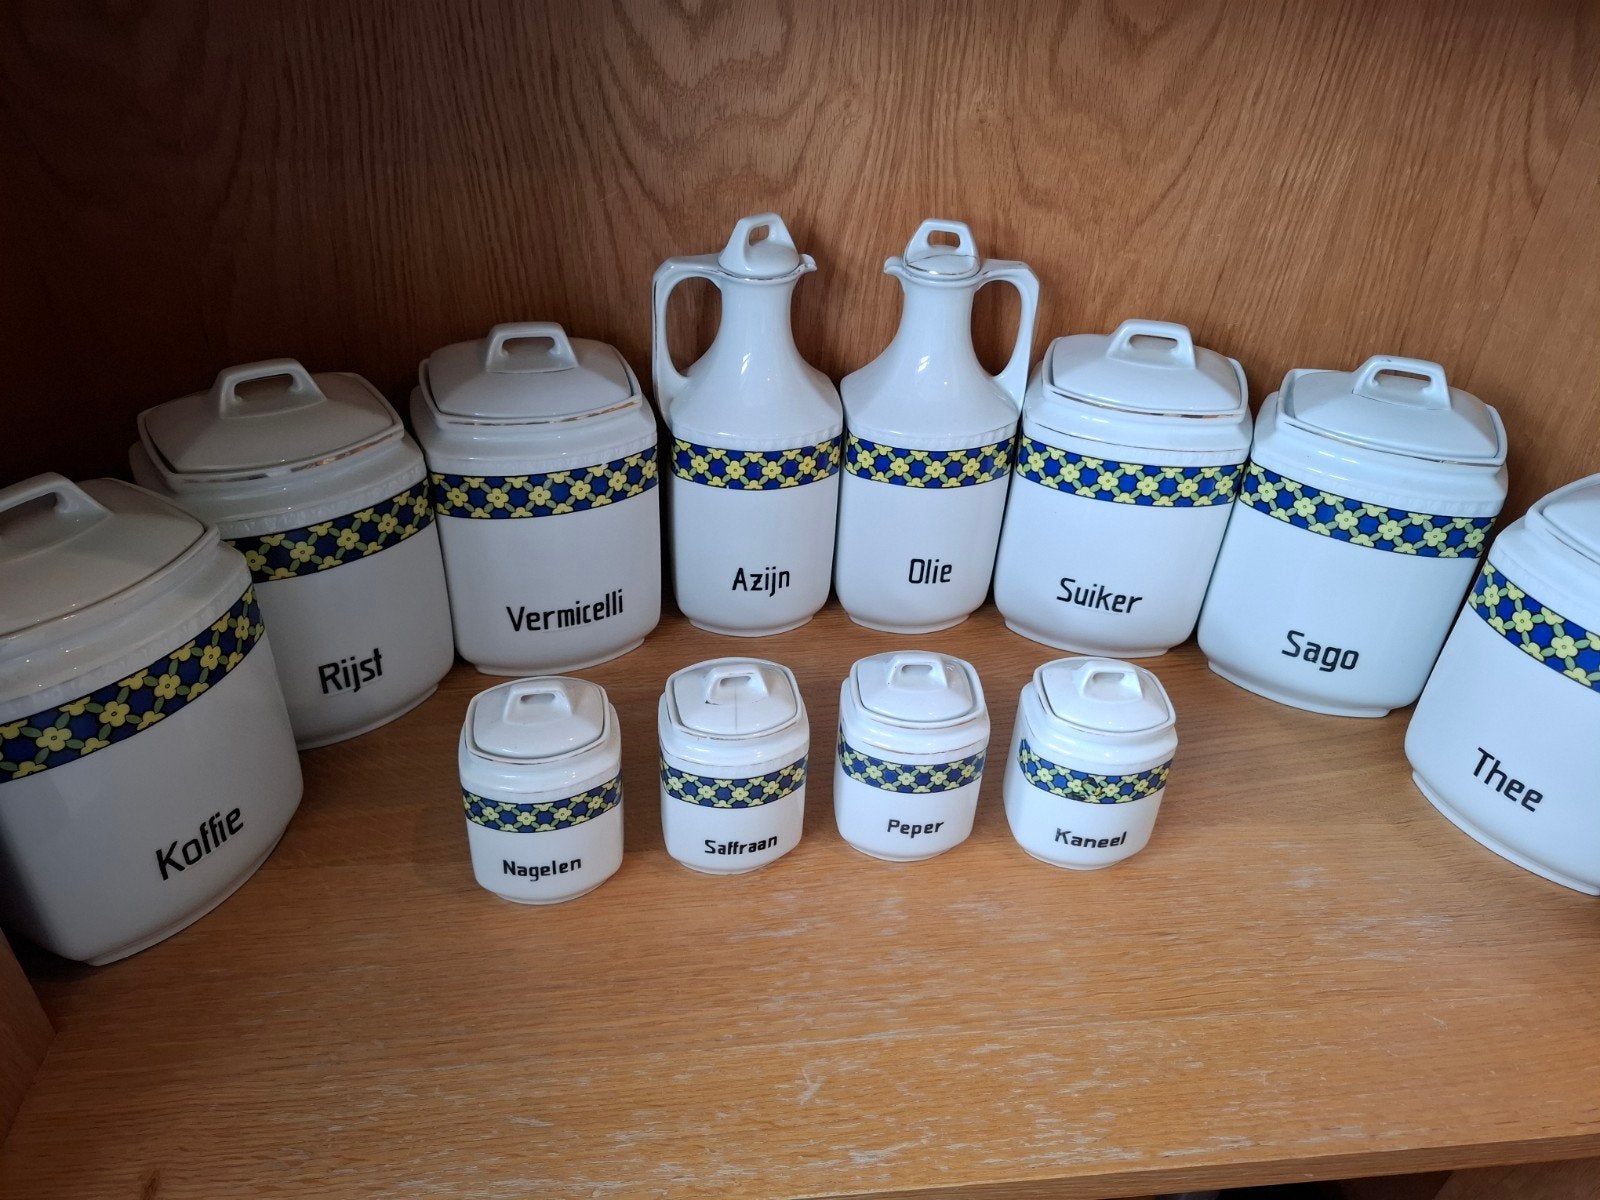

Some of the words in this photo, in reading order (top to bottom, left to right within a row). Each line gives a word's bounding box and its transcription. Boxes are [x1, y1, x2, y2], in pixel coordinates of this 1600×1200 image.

[731, 566, 791, 597] Azijn
[908, 558, 953, 585] Olie
[505, 588, 624, 632] Vermicelli
[1057, 577, 1143, 614] Suiker
[1281, 629, 1360, 673] Sago
[317, 647, 383, 695] Rijst
[1473, 746, 1544, 813] Thee
[155, 806, 245, 881] Koffie
[704, 835, 778, 856] Saffraan
[887, 819, 945, 839] Peper
[1054, 827, 1127, 849] Kaneel
[502, 857, 582, 882] Nagelen
